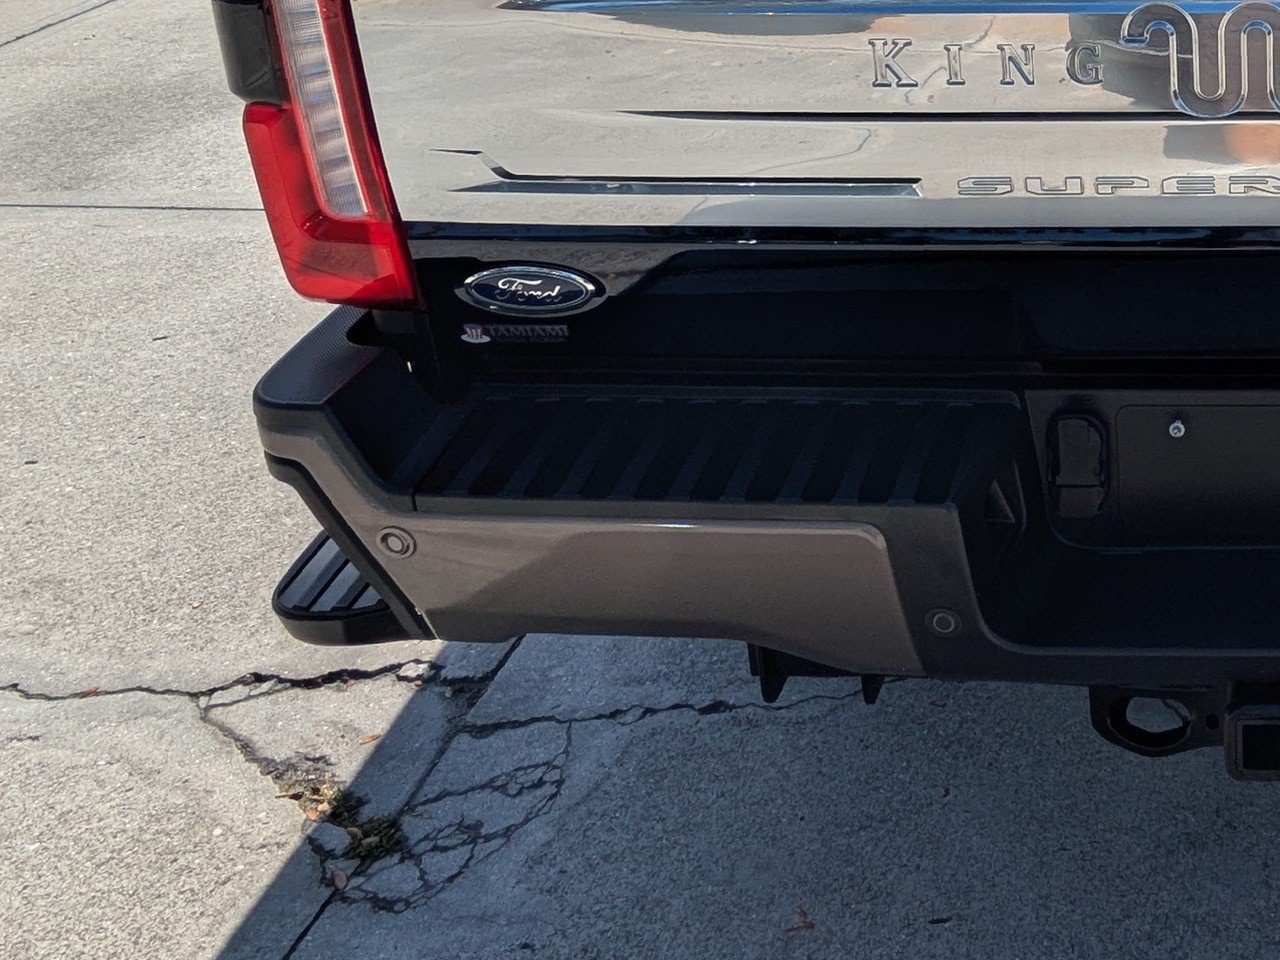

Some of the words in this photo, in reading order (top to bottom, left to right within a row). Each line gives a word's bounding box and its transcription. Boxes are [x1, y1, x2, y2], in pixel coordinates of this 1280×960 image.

[868, 38, 1104, 87] KING
[494, 277, 562, 302] Ford
[484, 324, 569, 336] TAMIAMI
